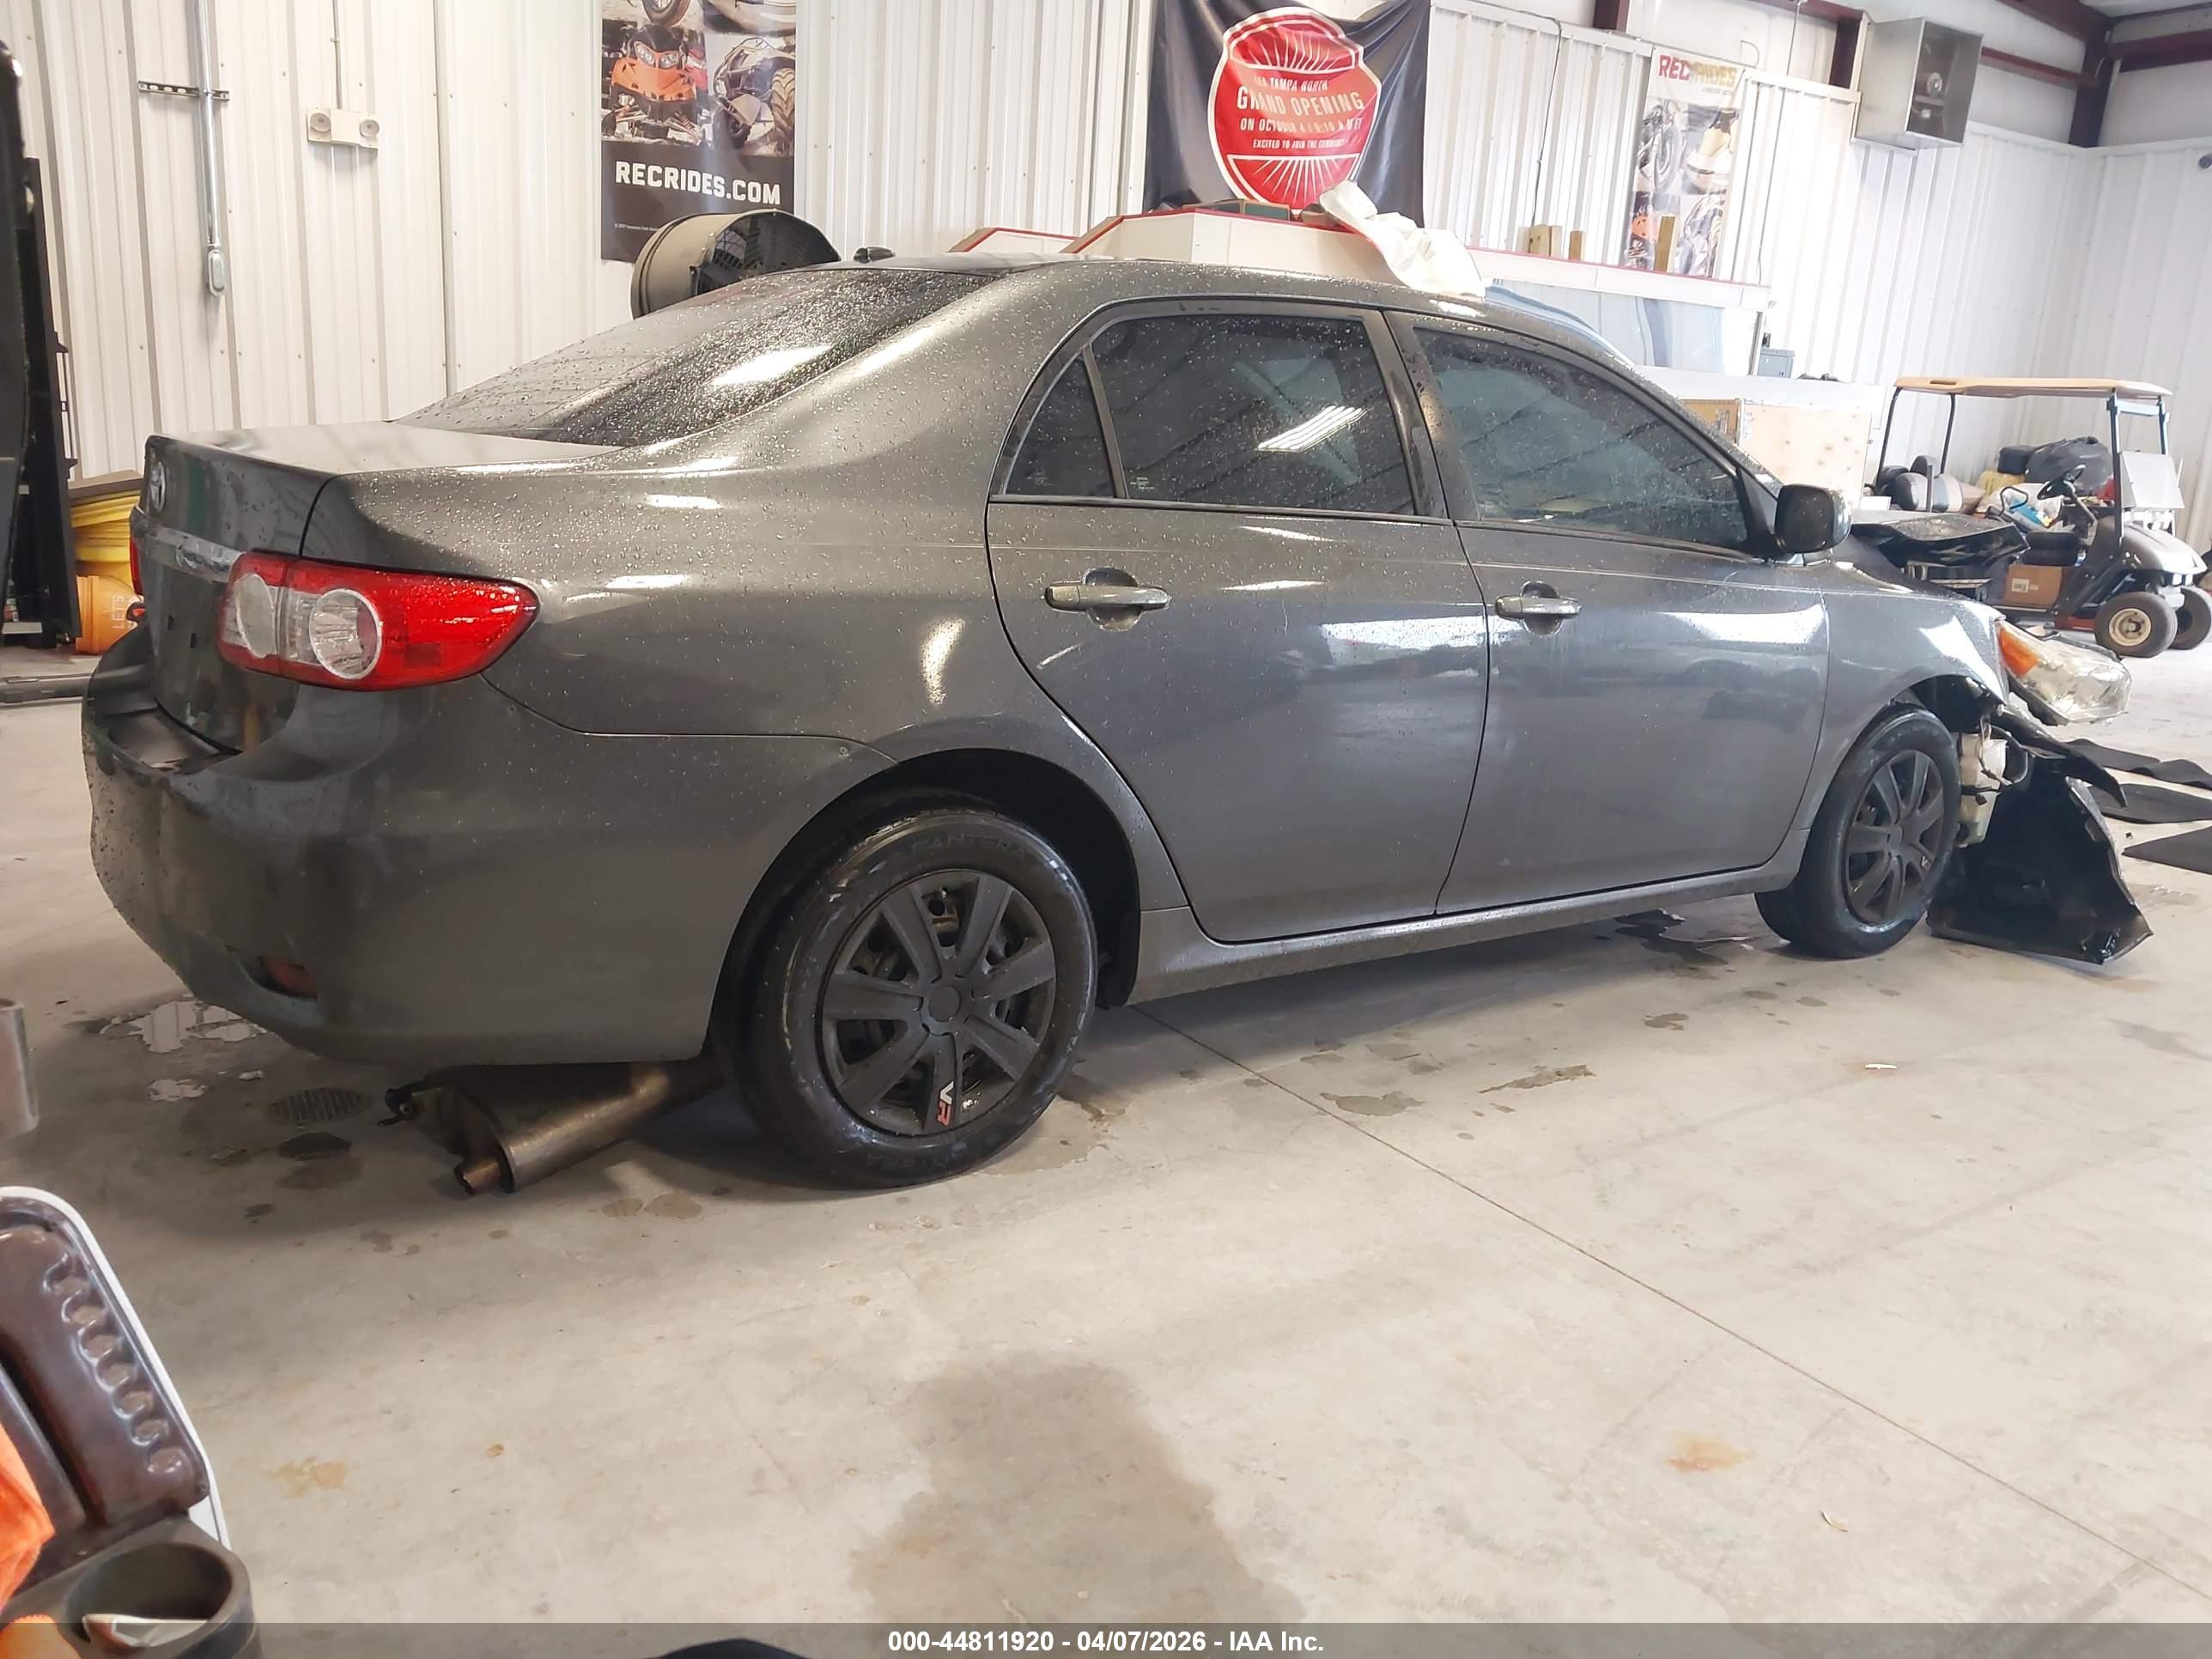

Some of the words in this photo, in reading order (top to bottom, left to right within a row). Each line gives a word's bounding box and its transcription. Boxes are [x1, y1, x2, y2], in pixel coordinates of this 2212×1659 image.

[1269, 77, 1297, 92] TAMPA
[1237, 85, 1286, 115] GRAND
[1291, 91, 1365, 117] OPENING
[1240, 117, 1254, 131] ON
[1253, 138, 1280, 149] EXCITED
[1281, 139, 1291, 149] TO
[615, 160, 781, 205] RECRIDES.COM
